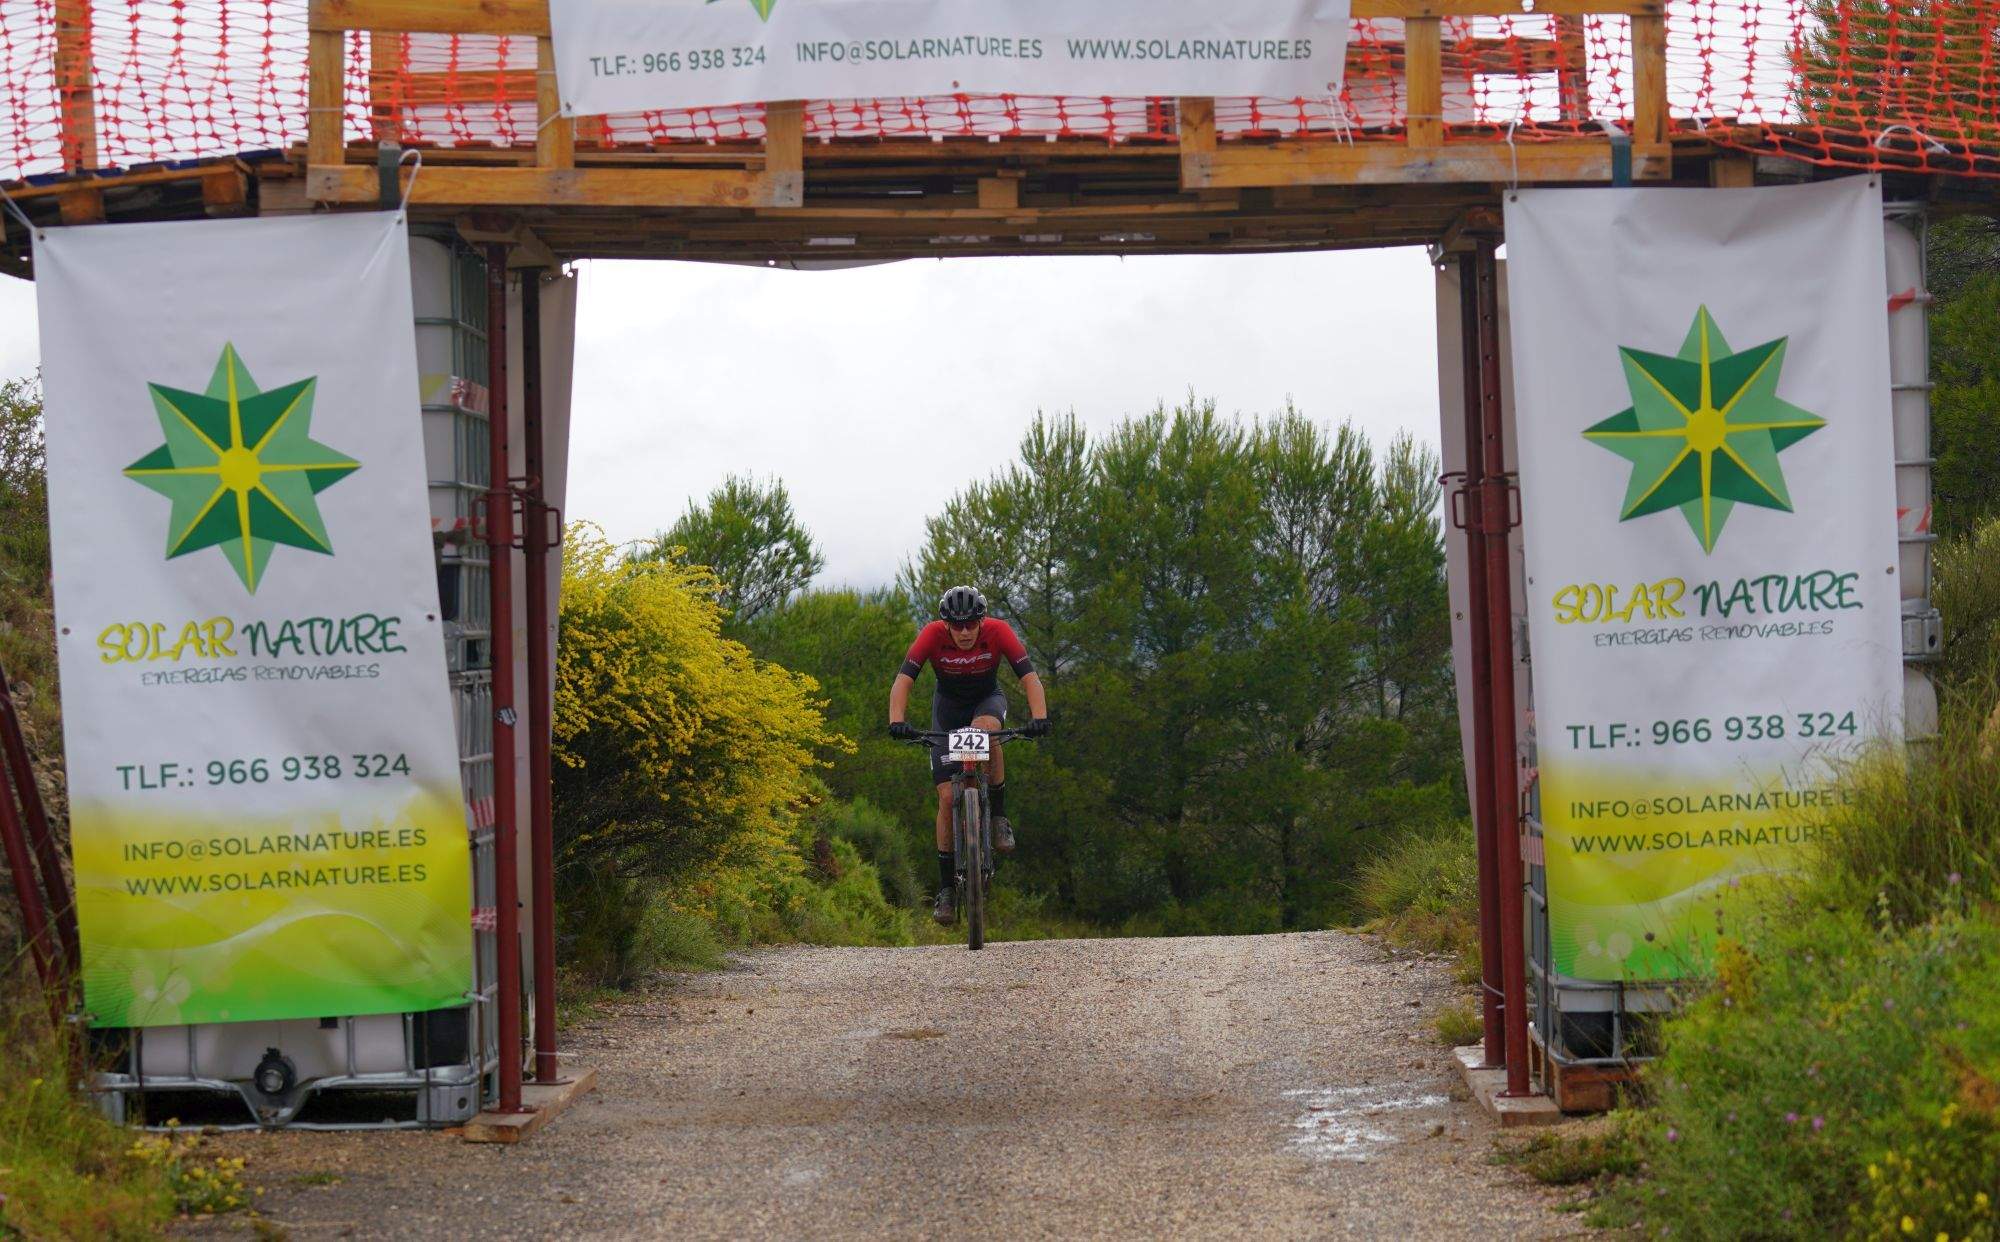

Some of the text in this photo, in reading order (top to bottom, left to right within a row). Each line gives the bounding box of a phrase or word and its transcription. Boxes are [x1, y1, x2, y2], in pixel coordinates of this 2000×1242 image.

[590, 45, 766, 78] TLF.: 966 938 324
[796, 35, 1042, 64] INFO@SOLARNATURE.ES
[1067, 39, 1312, 60] WWW.SOLARNATURE.ES
[1551, 570, 1863, 624] SOLAR NATURE
[96, 613, 407, 664] SOLAR NATURE
[1593, 620, 1834, 647] ENERGIAS RENOVABLES
[141, 663, 380, 686] ENERGIAS RENOVABLES
[952, 734, 985, 750] 242
[1566, 711, 1858, 750] TLF.: 966 938 324
[116, 753, 411, 791] TLF.: 966 938 324
[123, 828, 427, 862] INFO@SOLARNATURE.ES
[126, 864, 427, 896] WWW.SOLARNATURE.ES
